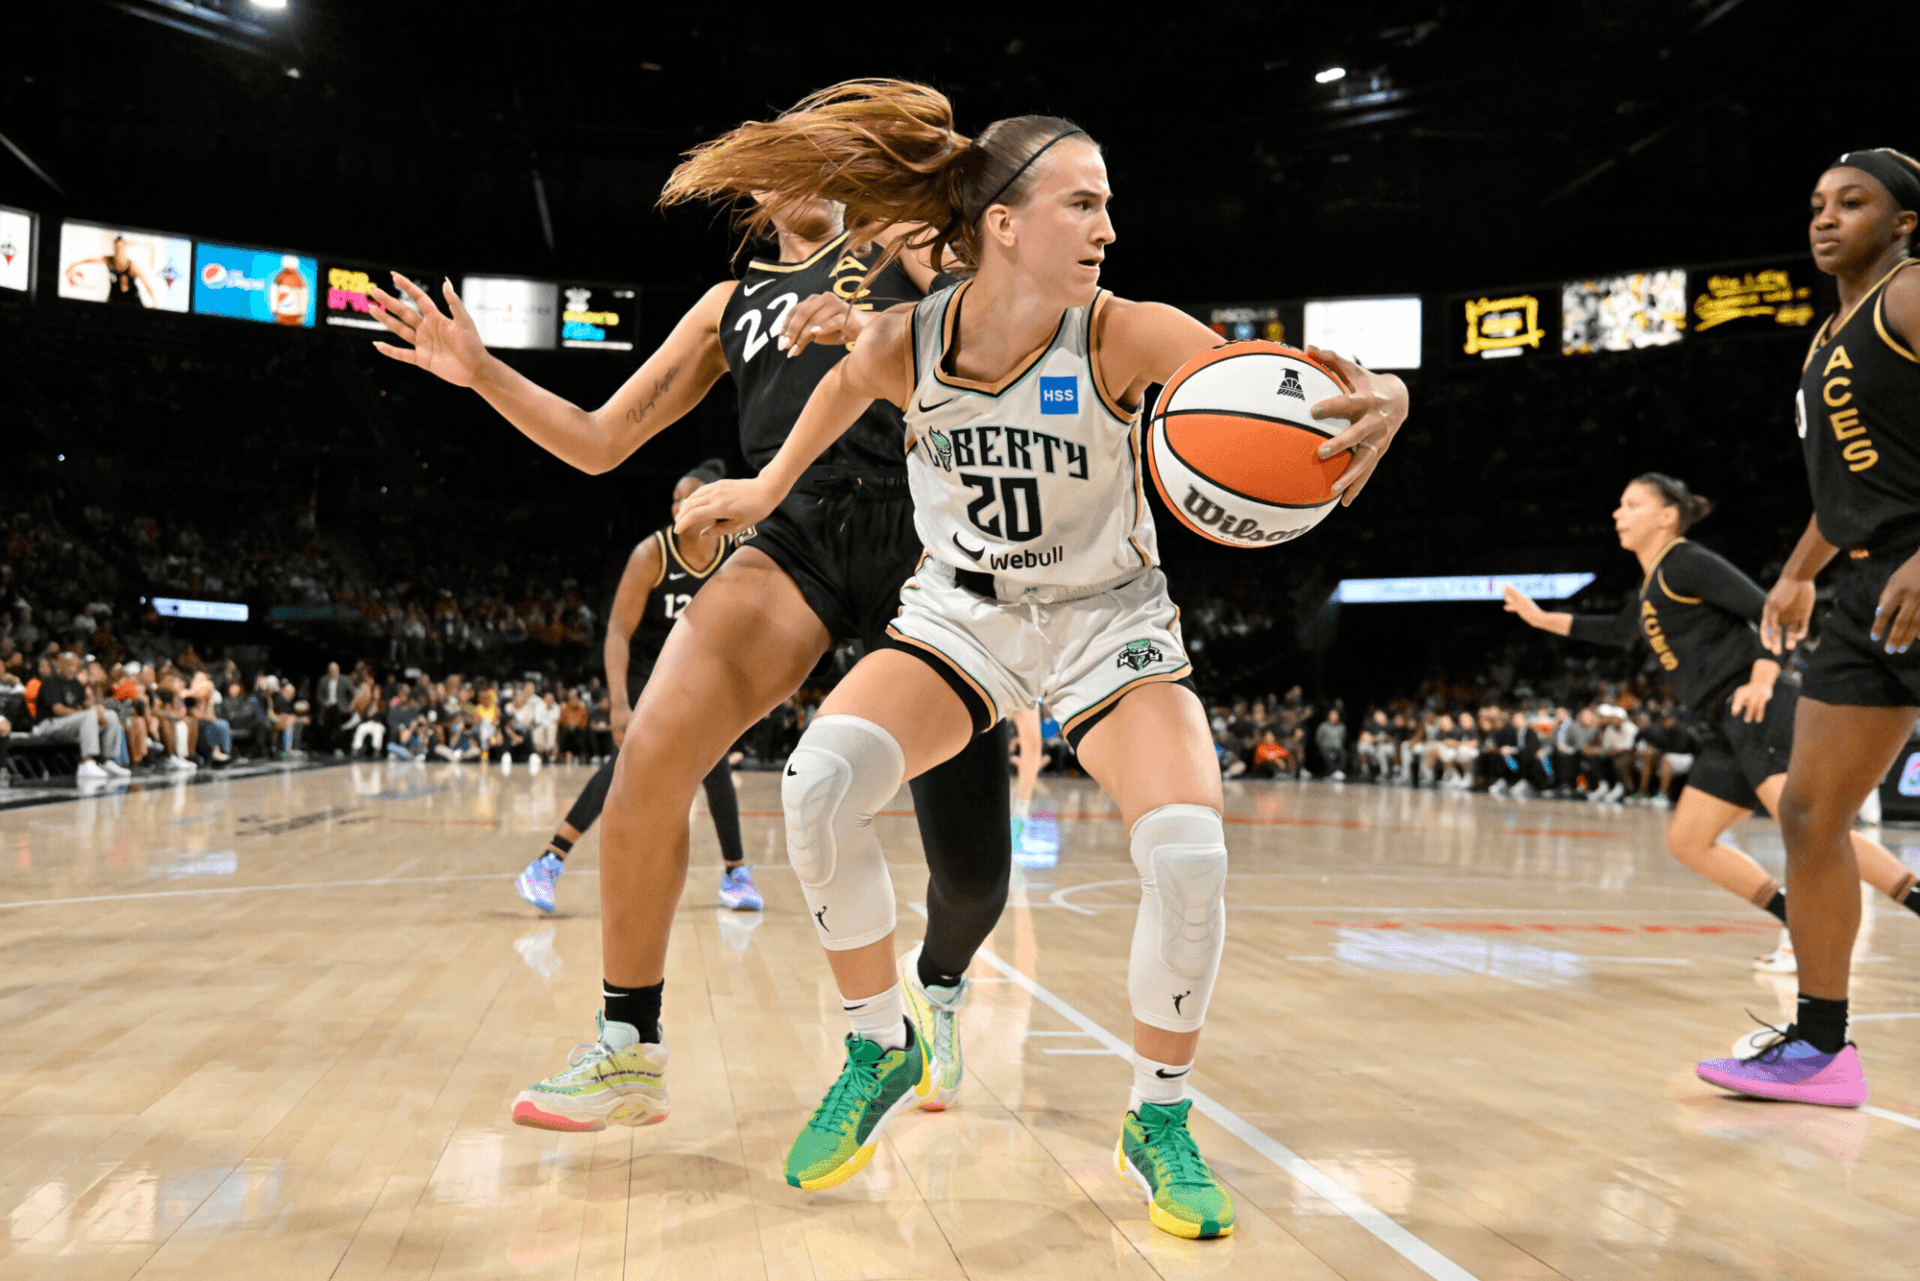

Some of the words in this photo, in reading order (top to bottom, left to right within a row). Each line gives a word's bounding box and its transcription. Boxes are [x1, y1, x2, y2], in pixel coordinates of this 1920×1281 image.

[734, 292, 799, 363] 22
[1043, 390, 1074, 401] HSS
[1823, 345, 1879, 472] ACES
[959, 472, 1043, 542] 20
[1183, 484, 1310, 543] Wilson
[990, 545, 1063, 570] Webull
[664, 593, 693, 619] 12
[1641, 600, 1679, 671] ACES
